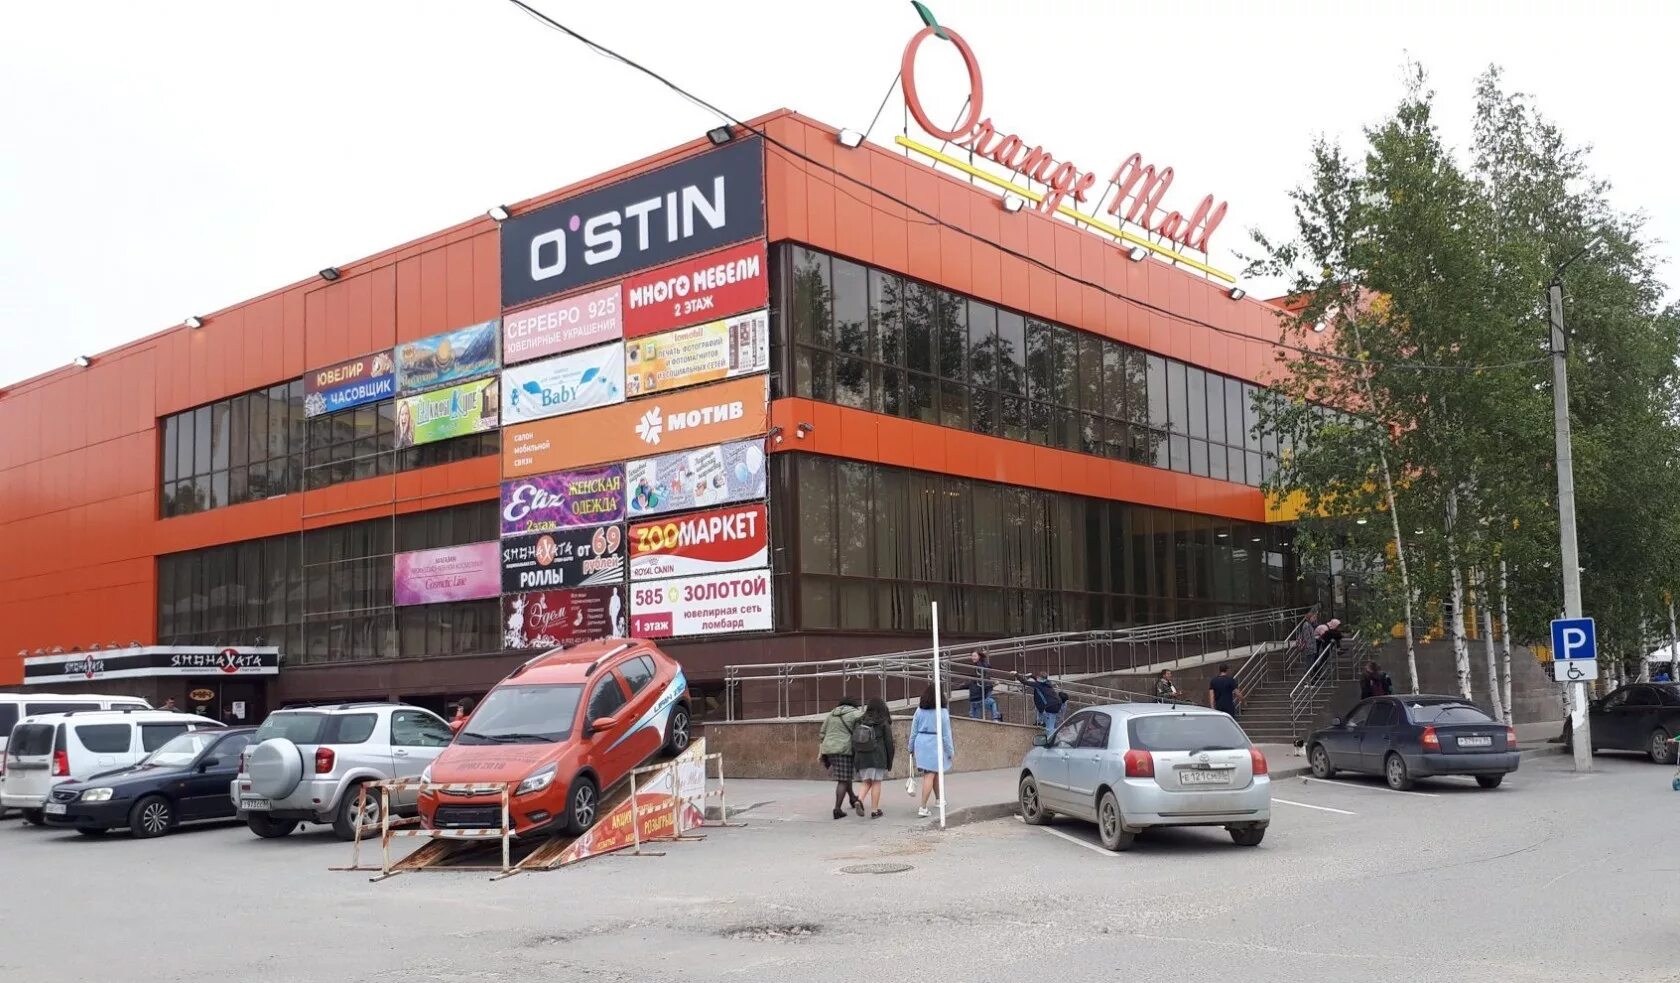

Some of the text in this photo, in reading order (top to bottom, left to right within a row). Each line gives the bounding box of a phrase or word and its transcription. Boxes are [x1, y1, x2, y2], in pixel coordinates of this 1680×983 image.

[901, 25, 1228, 254] Orange Mall
[629, 254, 760, 309] МНОГО МЕБЕЛИ
[507, 296, 616, 339] СЕРЕБРО 925
[674, 296, 714, 317] 2 ЭТАЖ
[508, 318, 616, 354] ЮВЕЛИРНЫЕ УКРАШЕНИЯ
[317, 362, 364, 386] ЮВЕЛИР
[330, 379, 391, 404] ЧАСОВЩИК
[667, 401, 744, 432] МОТИВ
[568, 476, 620, 496] ЖЕНСКАЯ
[503, 484, 565, 521] Eliz
[571, 496, 617, 515] ОДЕЖДА
[592, 525, 621, 556] 69
[582, 553, 620, 575] рублей
[634, 565, 674, 577] ROYAL CANIN
[520, 567, 564, 588] РОЛЛЫ
[635, 574, 767, 607] 585 ЗОЛОТОЙ
[684, 603, 762, 619] ювелирная сеть
[635, 619, 669, 632] 1 этаж
[701, 619, 744, 631] ломбард
[1562, 627, 1587, 659] P
